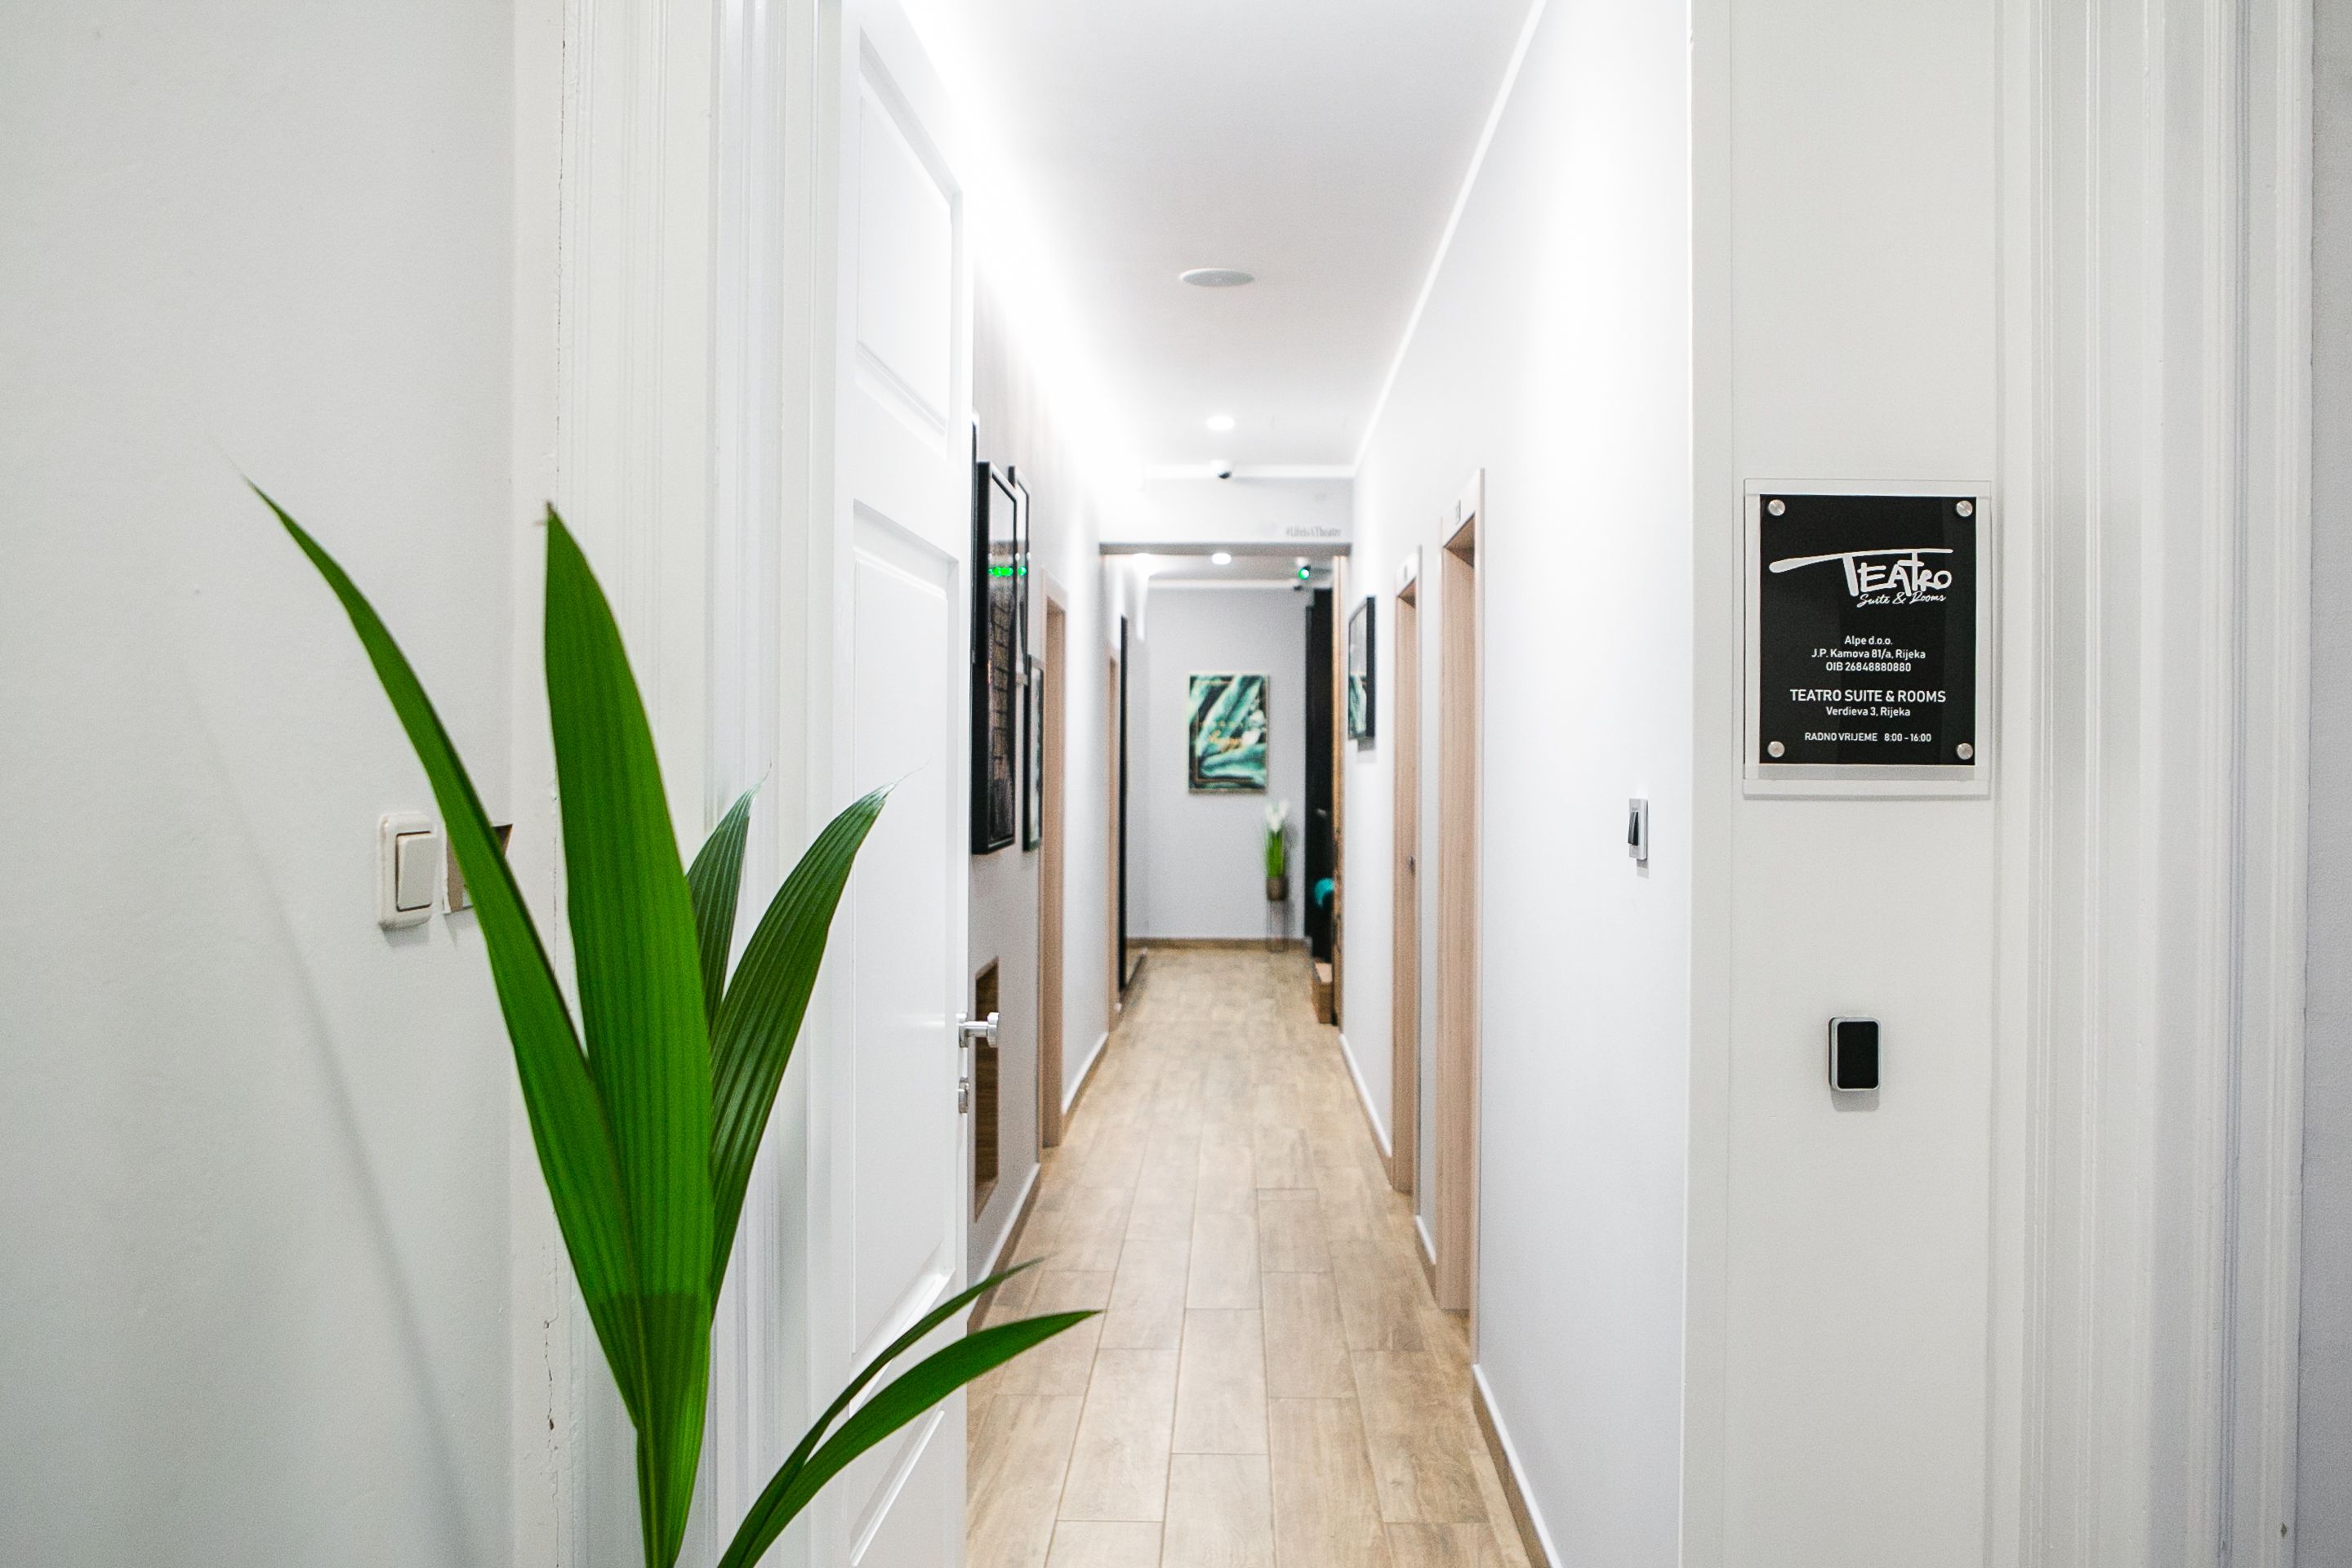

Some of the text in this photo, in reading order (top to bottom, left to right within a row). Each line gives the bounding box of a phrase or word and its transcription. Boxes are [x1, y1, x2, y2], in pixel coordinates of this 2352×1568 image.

[1856, 591, 1947, 608] Suite & Rooms
[1844, 635, 1893, 647] Alpe d.o.o.
[1811, 648, 1829, 658] J.P.
[1829, 648, 1870, 659] Kamova
[1895, 648, 1927, 661] Rijeka
[1825, 661, 1912, 672] OIB 26848880880
[1789, 688, 1947, 703] TEATRO SUITE & ROOMS
[1825, 706, 1869, 716] Verdieva
[1880, 706, 1911, 719] Rijeka
[1804, 732, 1838, 742] RADNO
[1838, 732, 1878, 742] VRIJEME
[1883, 733, 1903, 742] 8:00
[1909, 733, 1932, 742] 16:00
